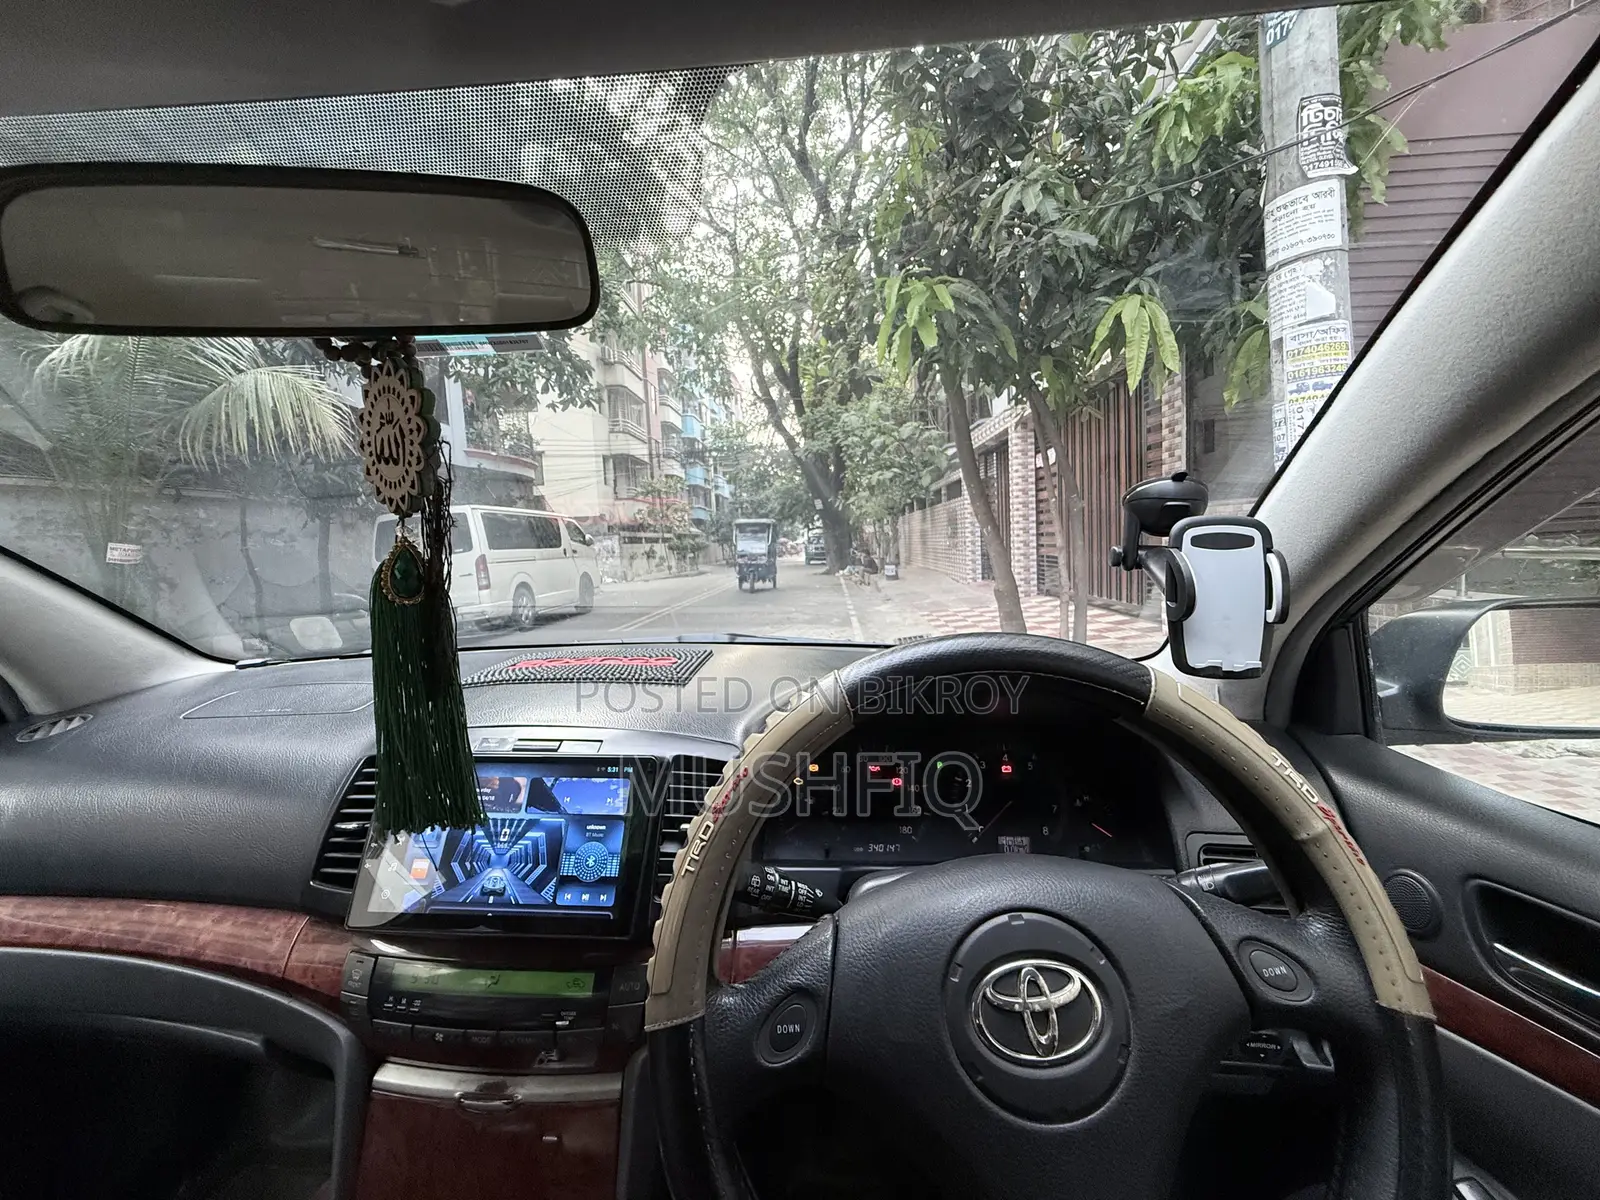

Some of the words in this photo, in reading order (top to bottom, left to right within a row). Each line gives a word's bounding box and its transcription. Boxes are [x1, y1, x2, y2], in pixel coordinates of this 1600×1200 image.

[1271, 752, 1320, 803] TRD
[899, 826, 913, 835] 180
[681, 821, 715, 877] TRD
[868, 844, 901, 853] 340147
[1262, 965, 1288, 978] DOWN
[619, 983, 641, 991] AUTO
[776, 1023, 801, 1035] DOWN
[1250, 1041, 1277, 1050] MIRROR
